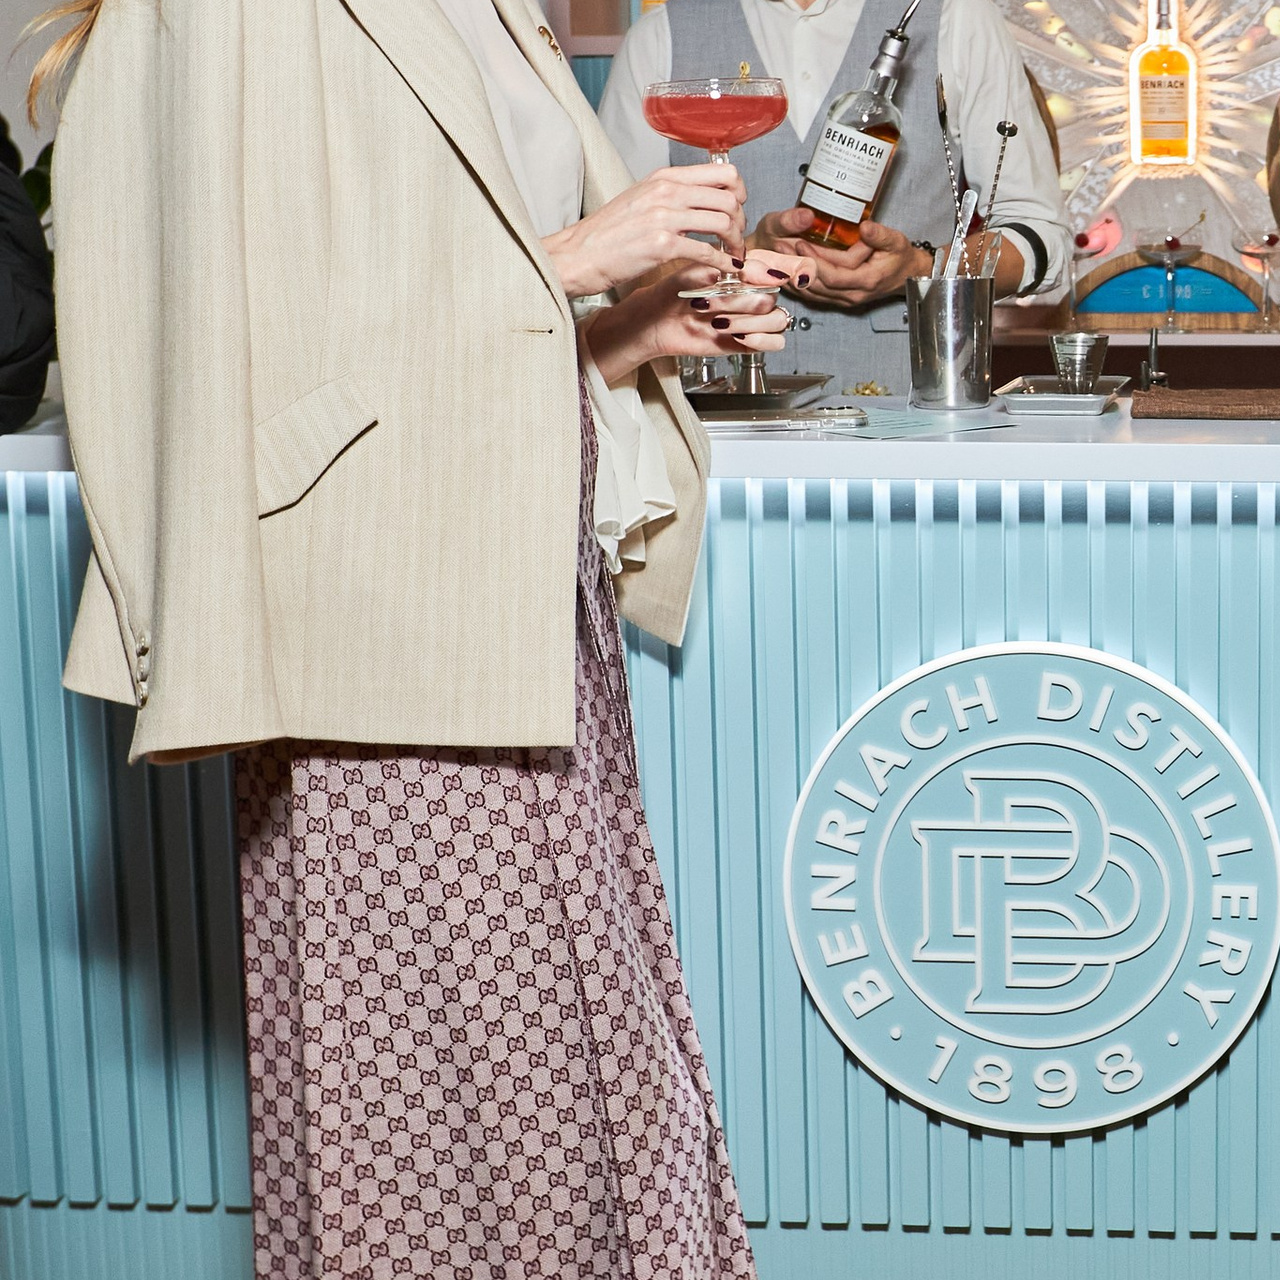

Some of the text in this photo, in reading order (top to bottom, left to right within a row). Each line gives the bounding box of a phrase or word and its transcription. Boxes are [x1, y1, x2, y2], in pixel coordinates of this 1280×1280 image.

[1141, 80, 1185, 89] BENRIACH
[825, 127, 884, 159] BENRIACH
[836, 171, 847, 180] 10
[1158, 284, 1192, 298] 198
[810, 671, 1259, 1029] BENRIACH DISTILLERY
[928, 1036, 1144, 1109] 1898
